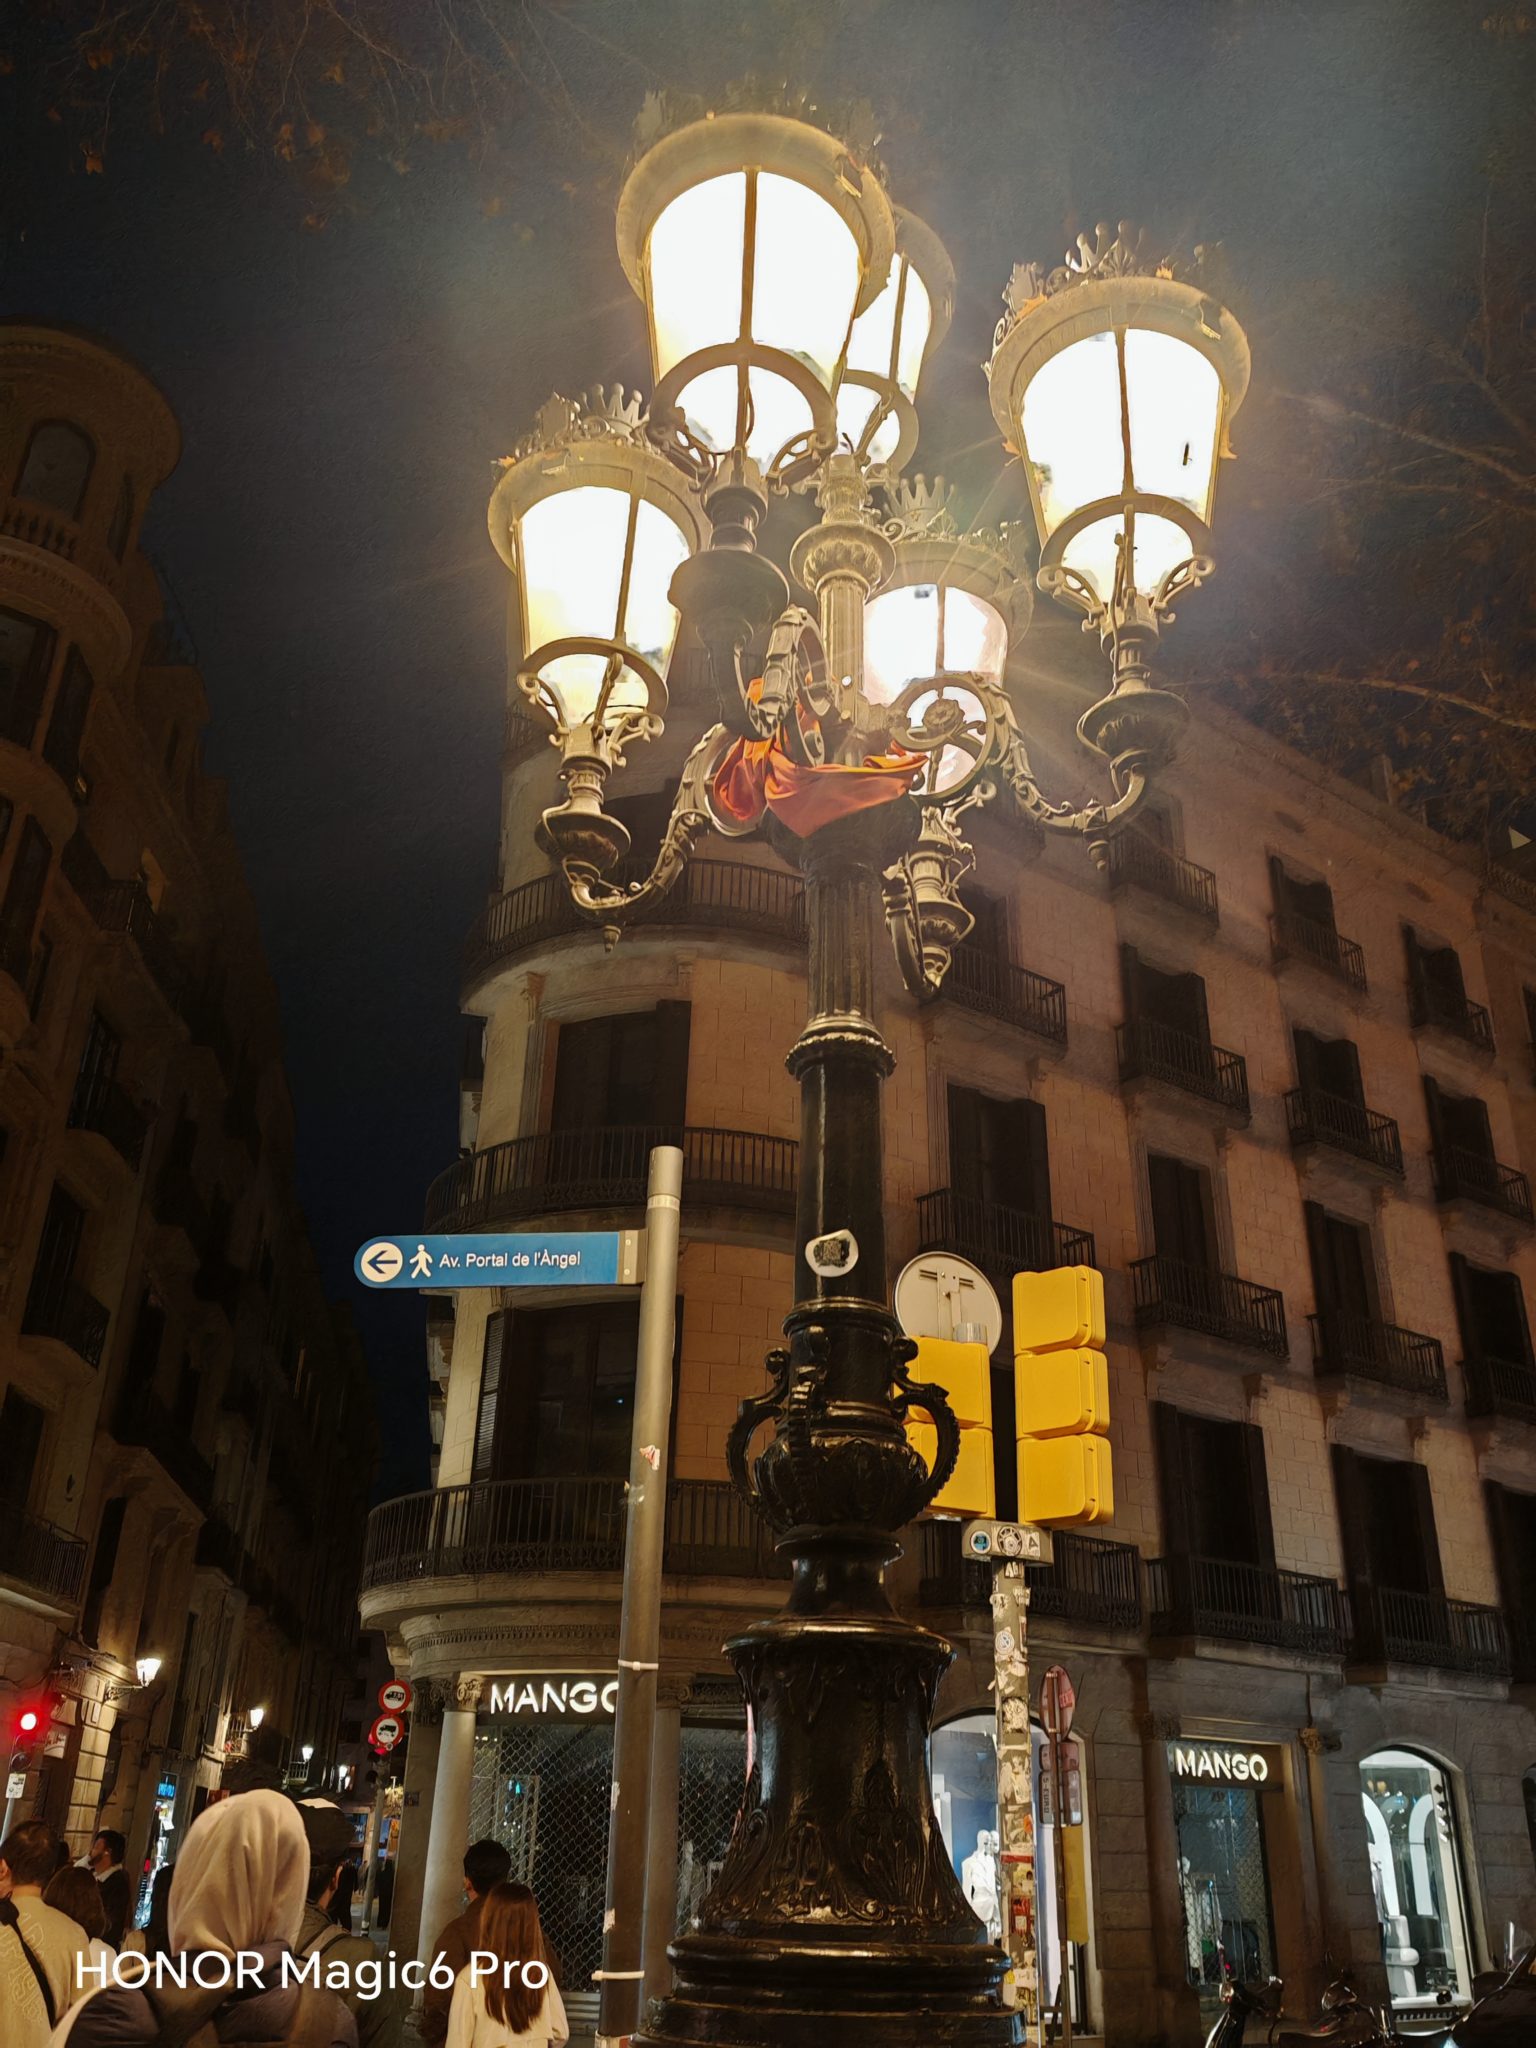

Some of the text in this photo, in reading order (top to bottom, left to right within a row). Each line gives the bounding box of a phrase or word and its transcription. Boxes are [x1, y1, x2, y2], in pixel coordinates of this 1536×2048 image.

[439, 1248, 580, 1269] Av. Portal de l'Àngel
[490, 1681, 620, 1715] MANGO
[1176, 1747, 1268, 1782] MANGO
